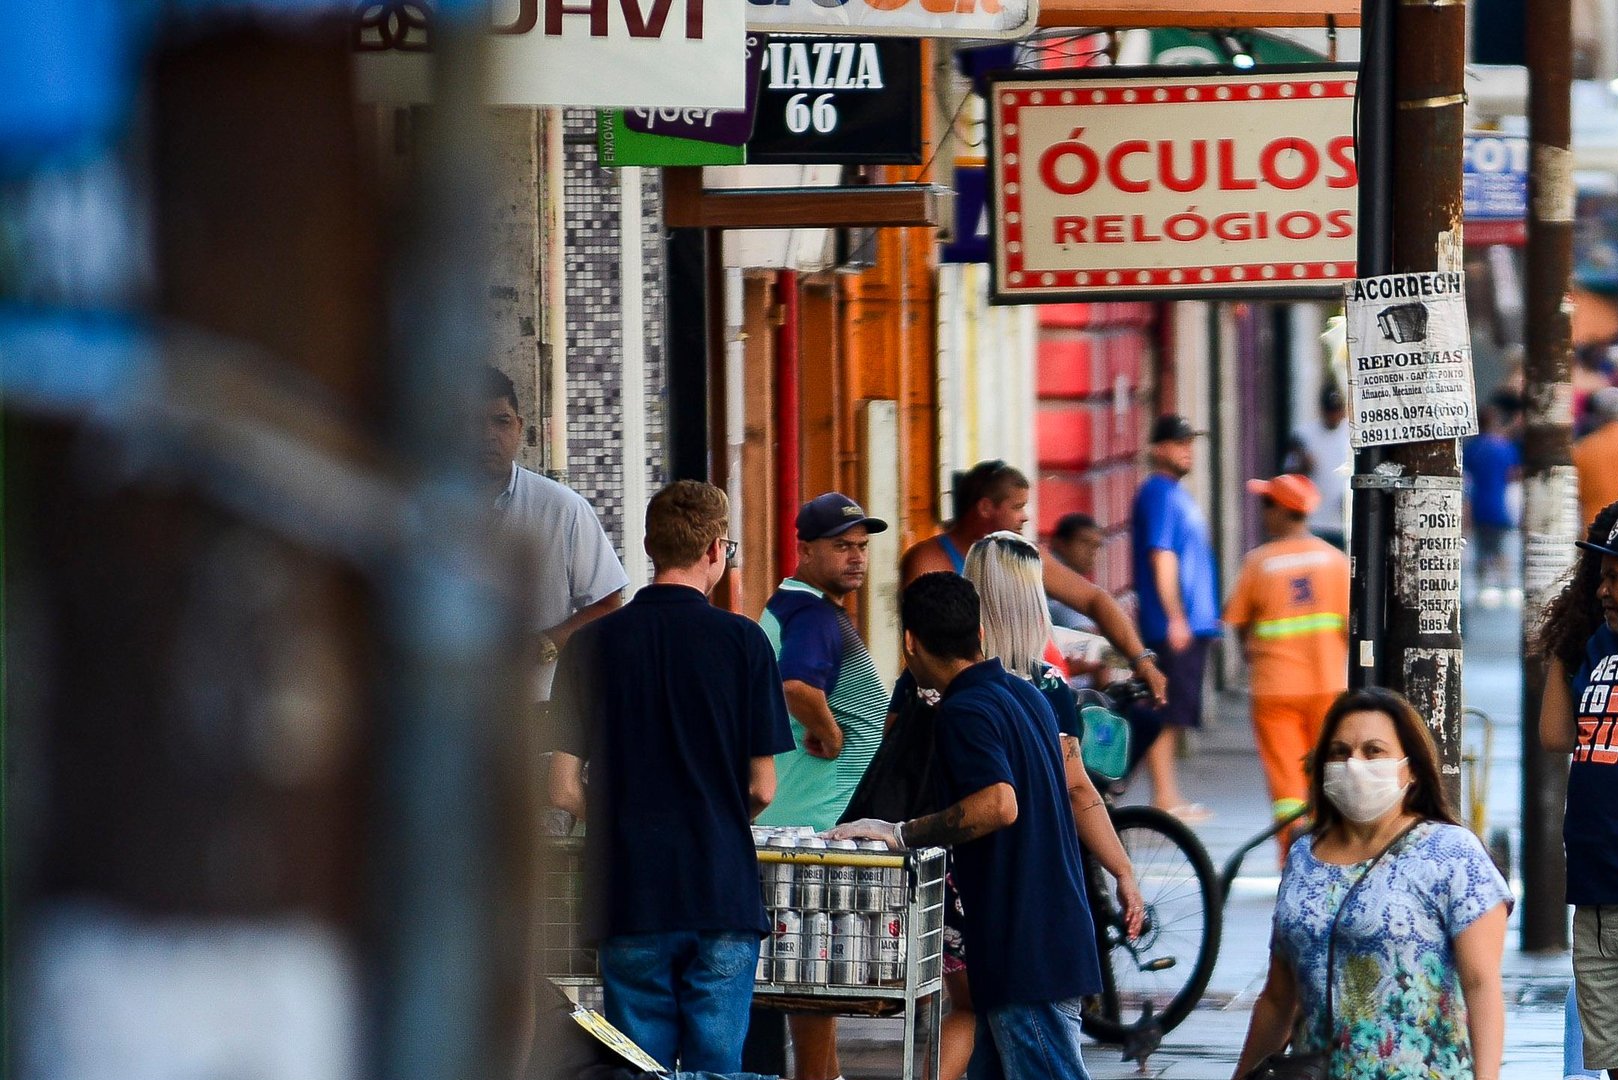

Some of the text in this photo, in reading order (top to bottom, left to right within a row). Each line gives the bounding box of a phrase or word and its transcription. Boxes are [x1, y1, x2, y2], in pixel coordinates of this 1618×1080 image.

[785, 93, 837, 134] 66
[1038, 127, 1358, 195] ÓCULOS
[1053, 205, 1354, 244] RELÓGIOS
[1354, 272, 1460, 301] ACORDEON
[1357, 350, 1463, 370] REFORMAS
[1364, 373, 1404, 385] ACORDEON
[1579, 684, 1610, 713] TO
